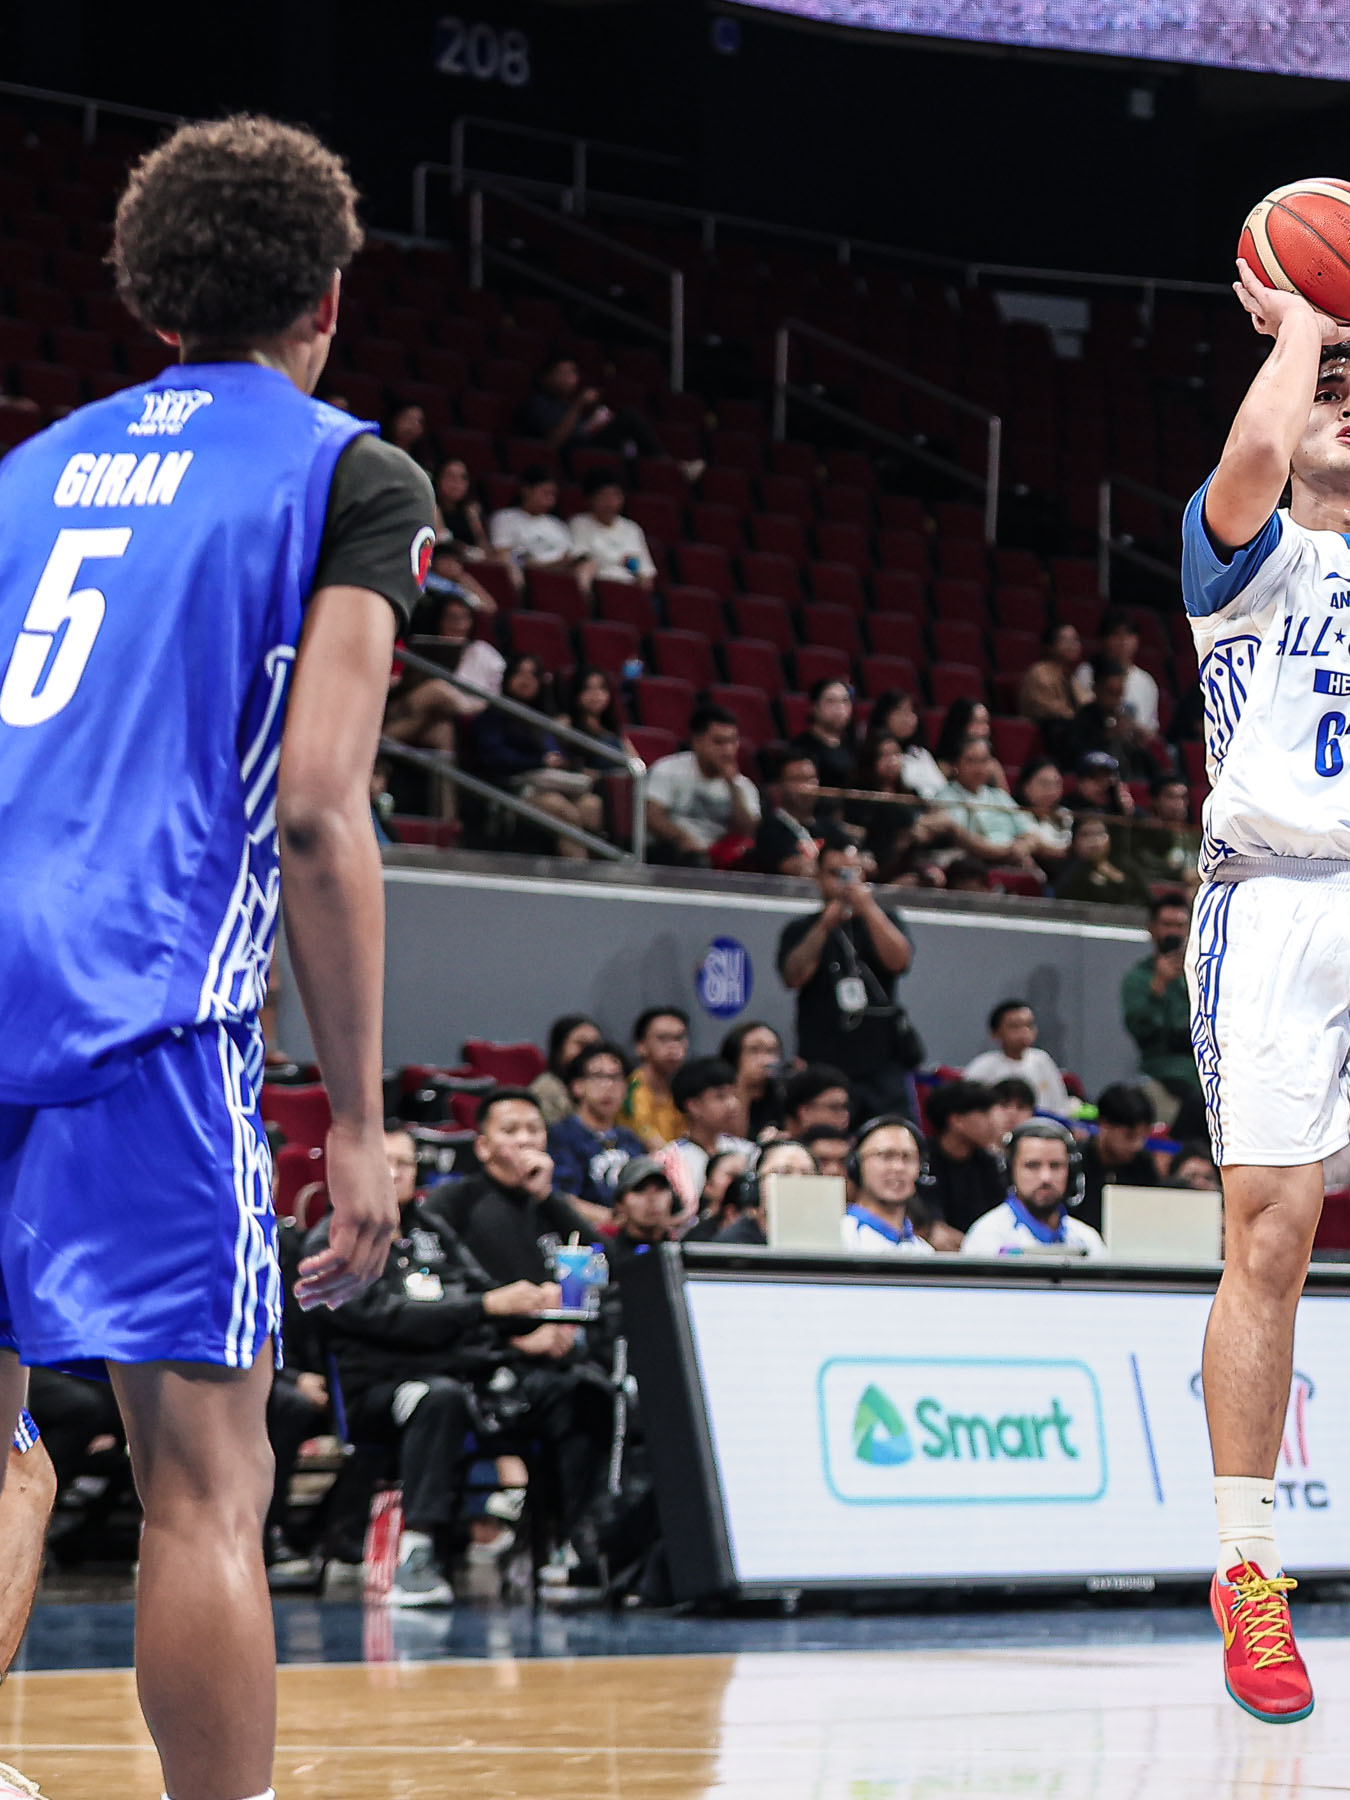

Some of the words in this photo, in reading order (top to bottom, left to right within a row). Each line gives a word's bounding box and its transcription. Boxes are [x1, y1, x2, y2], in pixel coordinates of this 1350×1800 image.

[437, 16, 530, 86] 208
[53, 450, 195, 508] GIRAN
[0, 527, 134, 729] 5
[1276, 615, 1334, 657] ALL
[915, 1397, 1080, 1460] Smart
